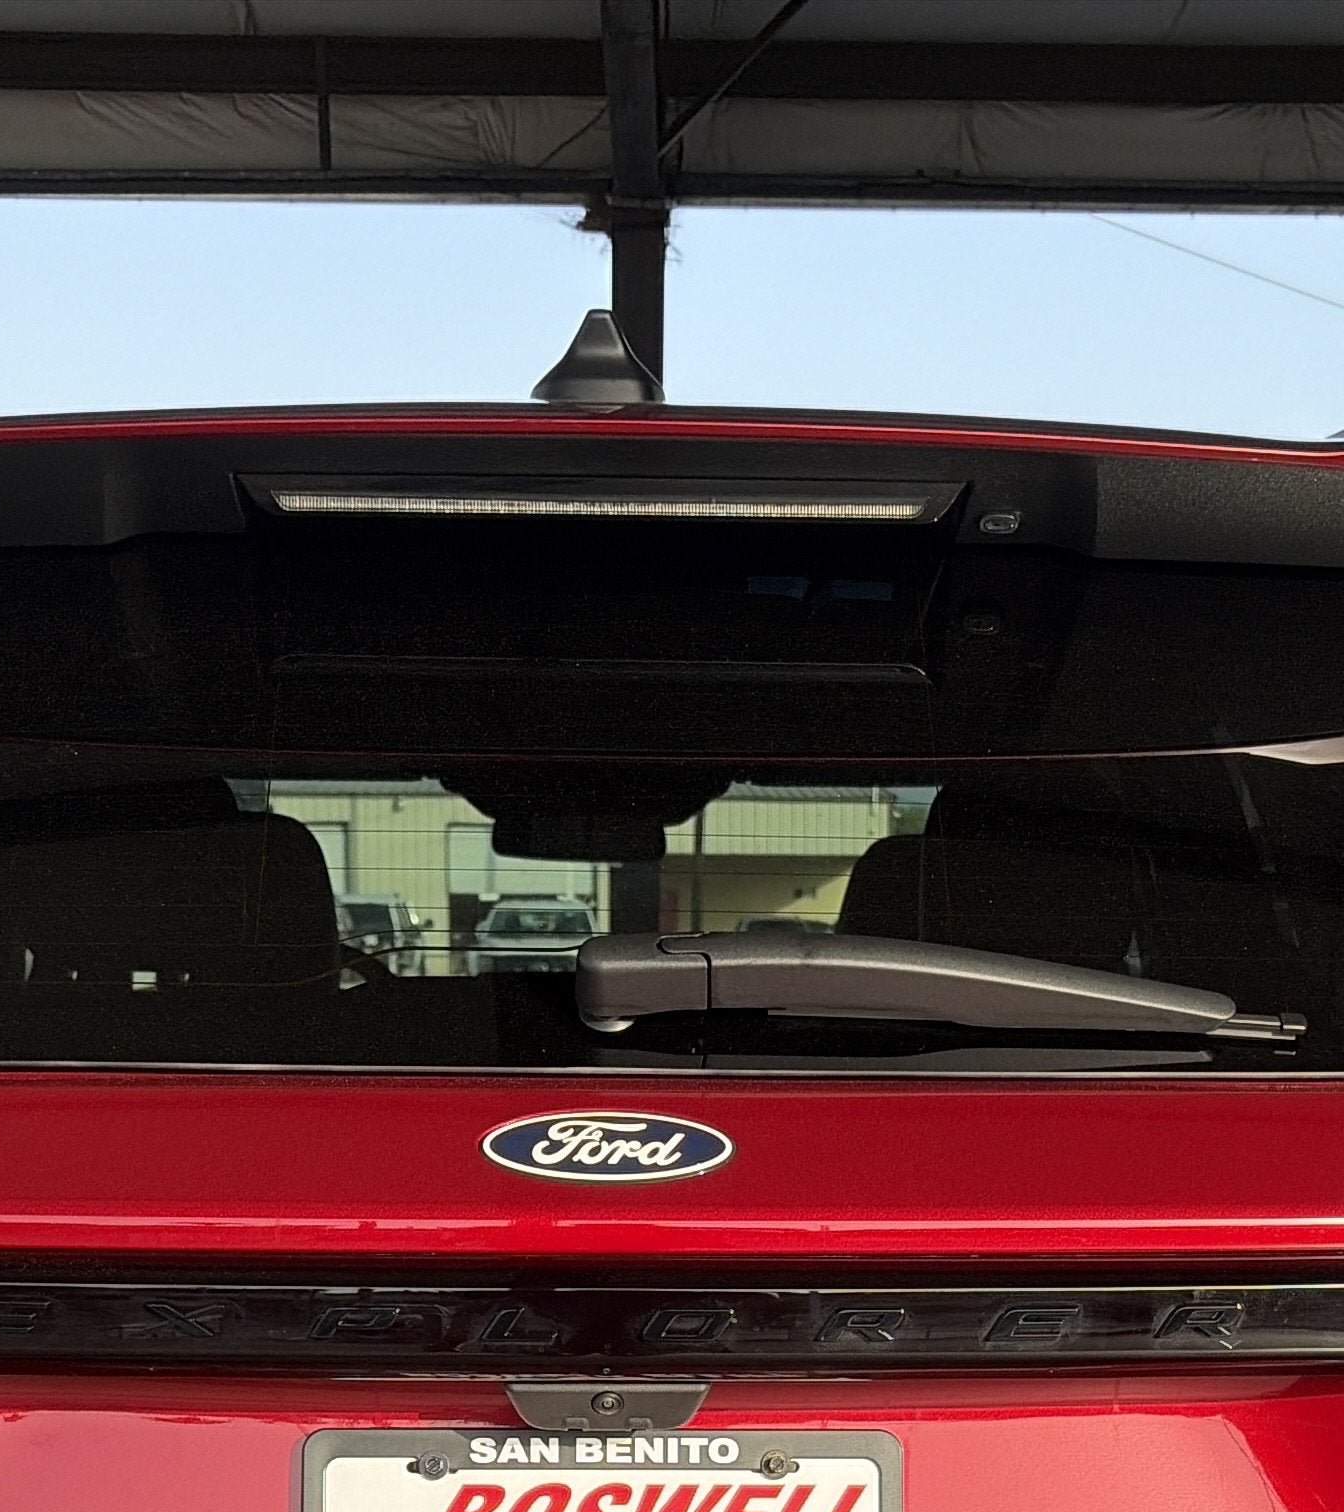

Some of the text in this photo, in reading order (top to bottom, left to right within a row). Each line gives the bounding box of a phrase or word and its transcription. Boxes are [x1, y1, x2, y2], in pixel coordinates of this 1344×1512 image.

[531, 1120, 686, 1166] Ford
[469, 1437, 739, 1464] SAN BENITO
